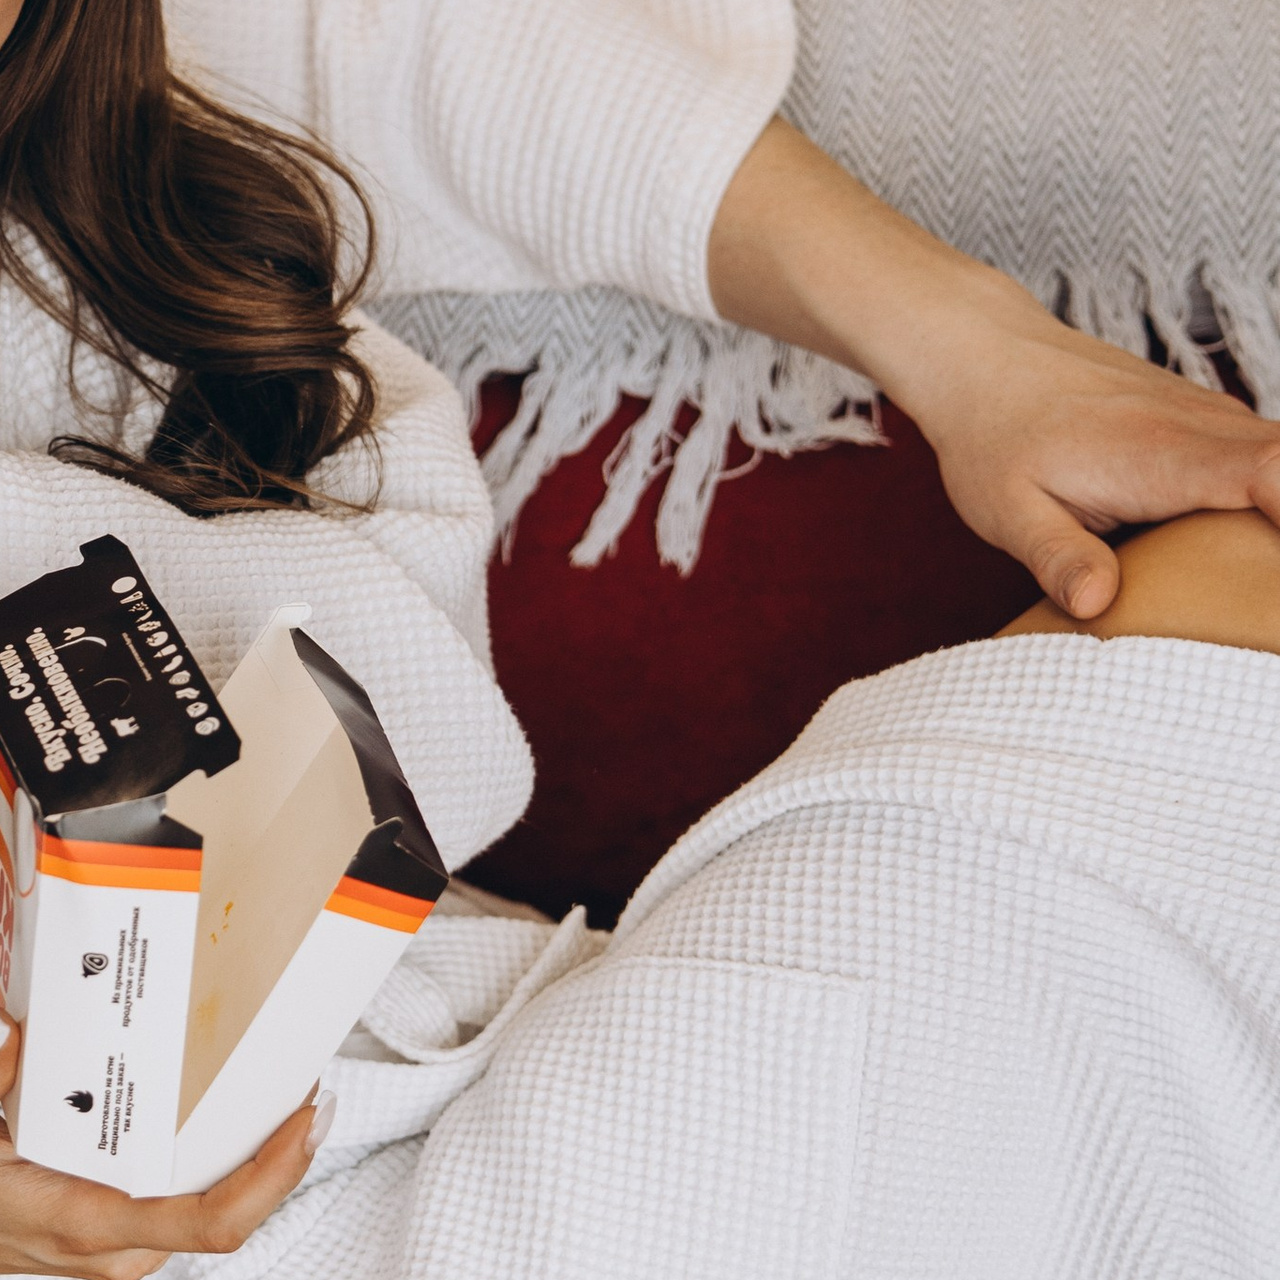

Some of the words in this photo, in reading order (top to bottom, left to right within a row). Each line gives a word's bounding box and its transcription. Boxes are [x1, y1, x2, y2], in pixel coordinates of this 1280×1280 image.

[26, 626, 108, 765] Необыкновенно.
[25, 696, 73, 772] Вкусно.
[128, 906, 140, 964] одобренных
[115, 929, 126, 991] премиальных
[127, 966, 134, 977] от
[136, 938, 148, 999] поставщиков
[111, 992, 120, 1004] Из
[122, 979, 133, 1027] продуктов
[106, 1077, 113, 1088] на
[107, 1055, 115, 1076] огне
[117, 1062, 125, 1087] заказ
[115, 1088, 124, 1105] под
[126, 1081, 135, 1117] вкуснее
[97, 1089, 111, 1150] Приготовлено
[110, 1106, 121, 1156] специально
[123, 1119, 131, 1133] так
